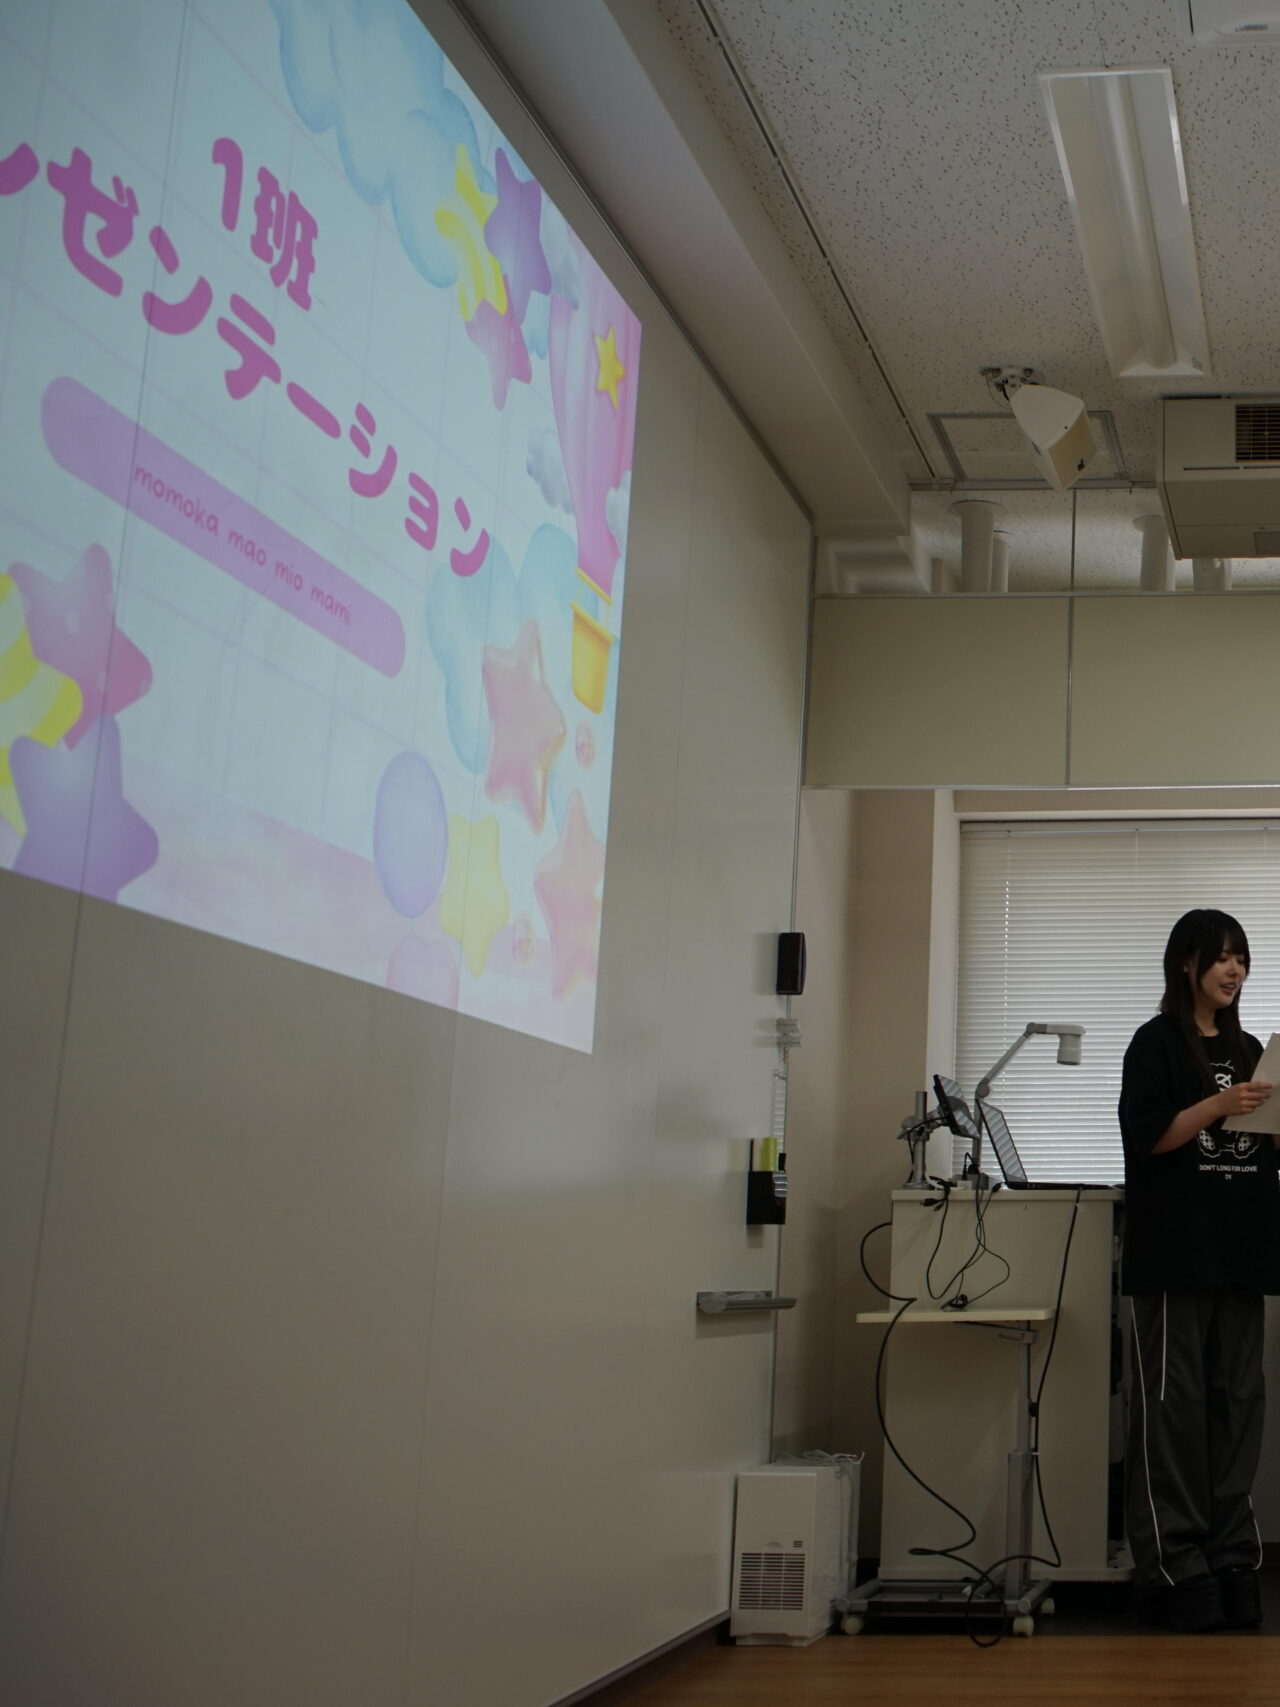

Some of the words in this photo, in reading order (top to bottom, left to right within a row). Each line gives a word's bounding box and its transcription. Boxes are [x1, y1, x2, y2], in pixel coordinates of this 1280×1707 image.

[212, 137, 318, 311] 1班
[135, 465, 219, 537] momoka
[228, 529, 266, 566] mao
[274, 561, 303, 591] mio
[310, 586, 352, 625] mami
